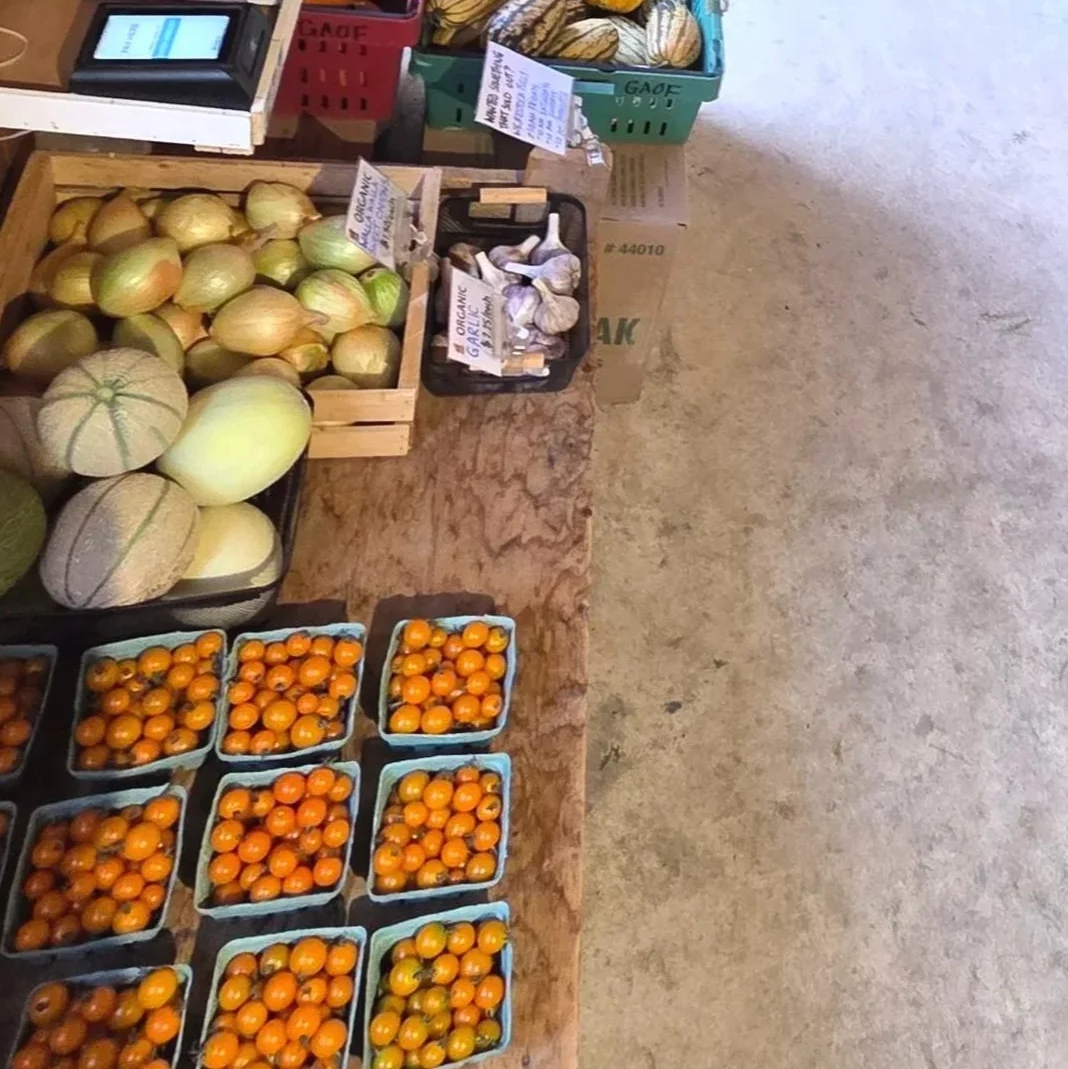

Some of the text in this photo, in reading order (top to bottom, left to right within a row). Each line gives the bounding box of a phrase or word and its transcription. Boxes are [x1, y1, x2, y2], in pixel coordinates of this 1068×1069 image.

[299, 19, 368, 40] GAOF
[624, 80, 683, 98] GAOF
[353, 169, 371, 225] ORGANIC
[618, 243, 665, 256] 44010
[455, 285, 467, 336] ORGANIC
[465, 304, 481, 358] GARLIC
